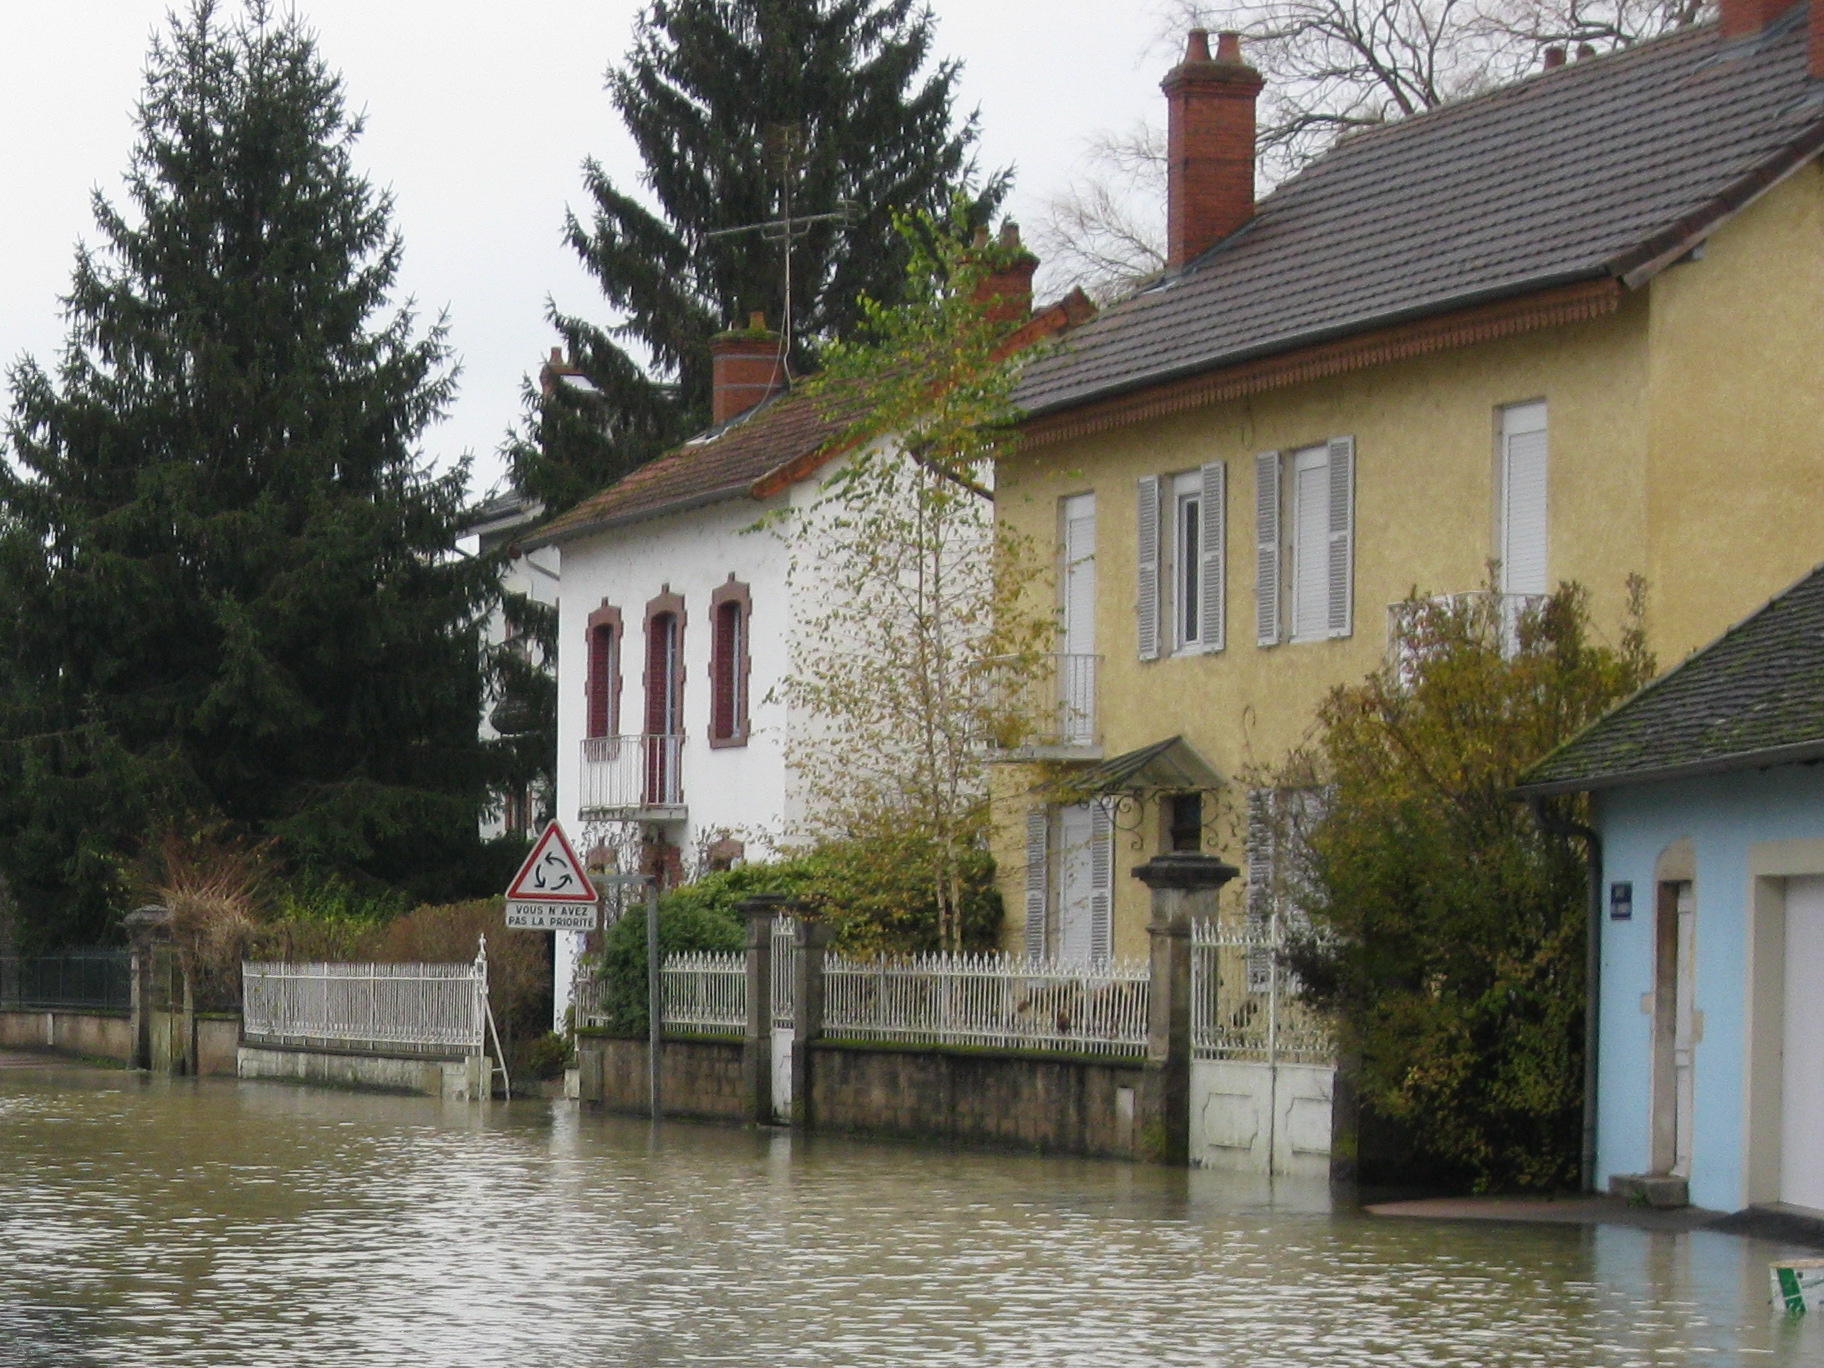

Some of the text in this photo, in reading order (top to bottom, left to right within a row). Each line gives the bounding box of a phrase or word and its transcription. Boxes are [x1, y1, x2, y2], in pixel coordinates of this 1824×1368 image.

[516, 905, 543, 915] VOUS
[508, 916, 595, 928] PAS LA PRIORITÉ
